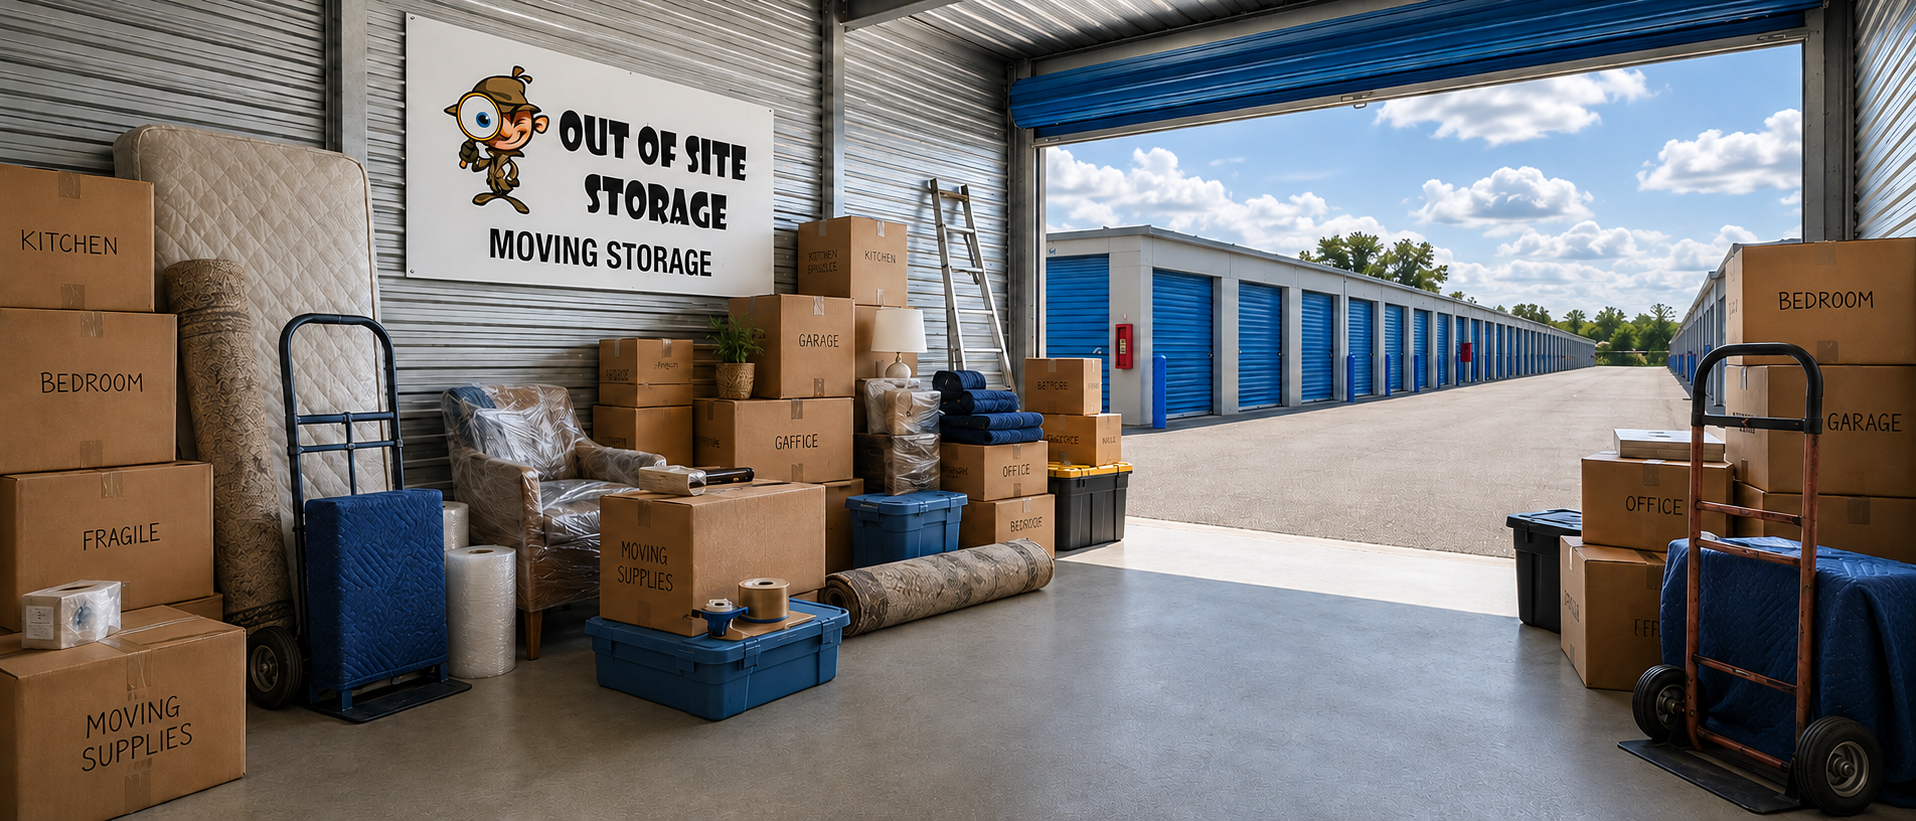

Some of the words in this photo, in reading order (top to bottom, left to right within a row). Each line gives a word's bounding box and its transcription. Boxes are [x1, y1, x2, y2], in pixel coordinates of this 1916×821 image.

[559, 110, 629, 159] OUT
[637, 128, 676, 168] OF
[685, 136, 746, 181] SITE
[585, 173, 726, 230] STORAGE
[22, 230, 116, 255] KITCHEN
[490, 228, 597, 267] MOVING
[607, 241, 711, 277] STORAGE
[865, 251, 895, 263] KITCHEN
[1779, 291, 1873, 310] BEDROOM
[798, 334, 839, 348] GARAGE
[41, 372, 142, 393] BEDROOM
[1828, 413, 1902, 432] GARAGE
[776, 434, 818, 450] GAFFICE
[1002, 463, 1030, 477] OFFICE
[1626, 496, 1683, 515] OFFICE
[84, 523, 160, 550] FRAGILE
[621, 541, 667, 566] MOVING
[617, 565, 673, 592] SUPPLIES
[87, 695, 180, 739] MOVING
[82, 722, 192, 771] SUPPLIES
